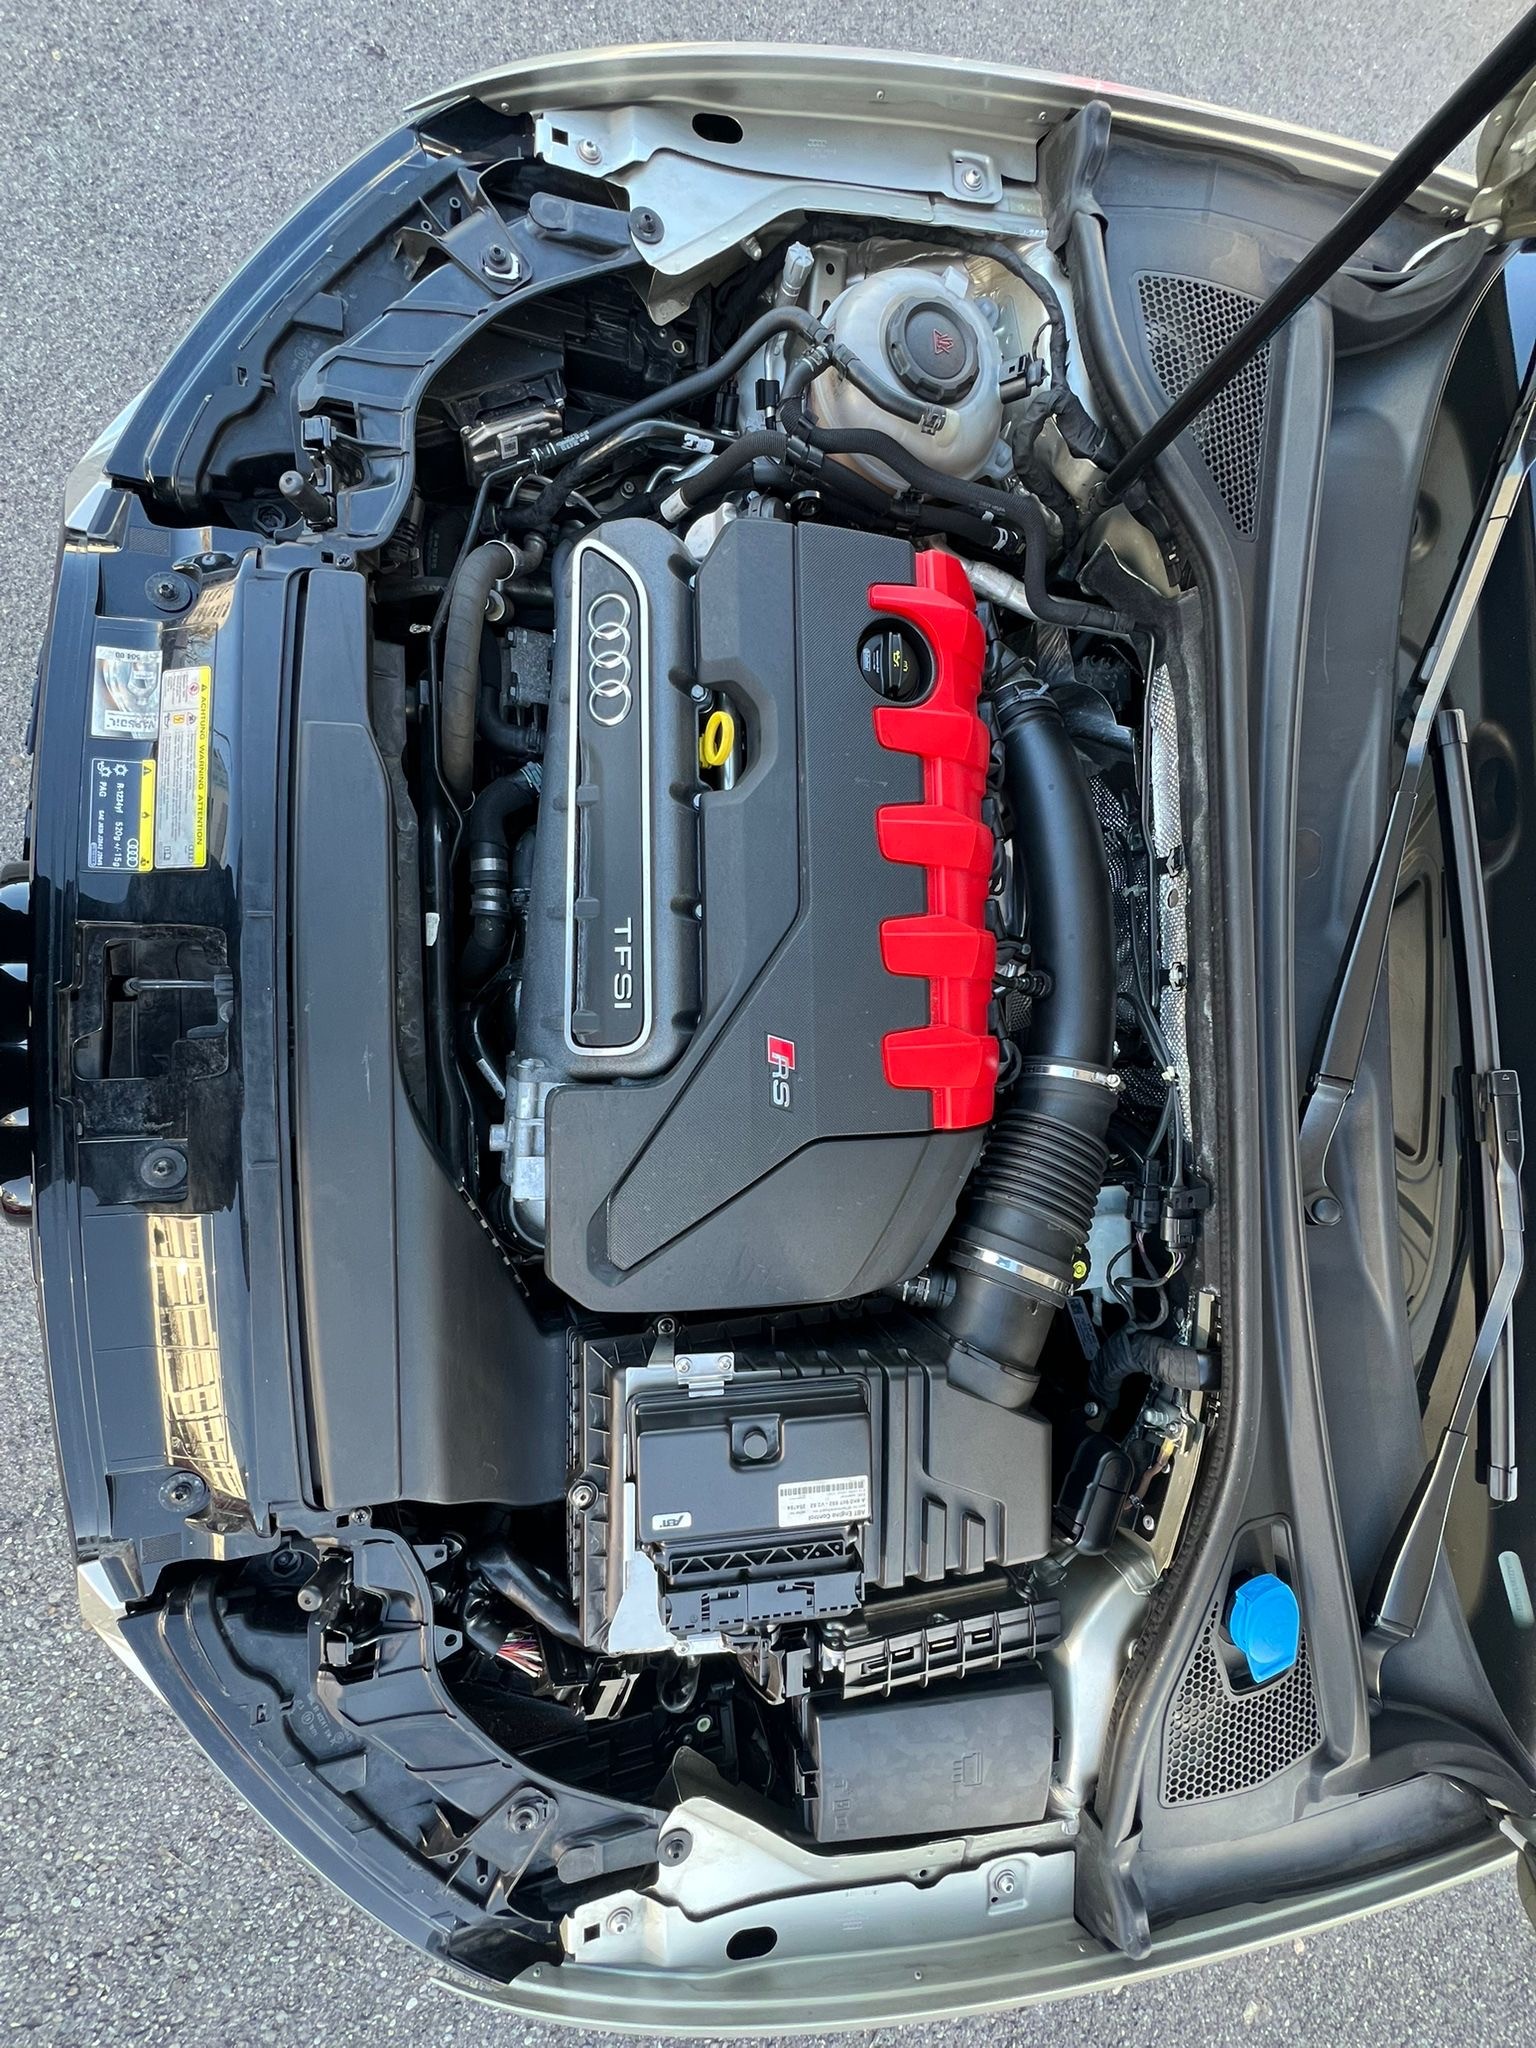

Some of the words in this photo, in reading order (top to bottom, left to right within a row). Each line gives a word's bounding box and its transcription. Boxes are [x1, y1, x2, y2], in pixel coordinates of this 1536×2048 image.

[199, 696, 207, 740] ACHTUNG
[98, 781, 107, 798] PAG
[114, 782, 125, 814] R-1234yf
[113, 821, 124, 841] 520g
[196, 795, 204, 846] ATTENTION
[613, 917, 632, 1009] TFSI
[771, 1052, 791, 1108] RS
[663, 1515, 684, 1528] ABT
[808, 1513, 831, 1521] Control
